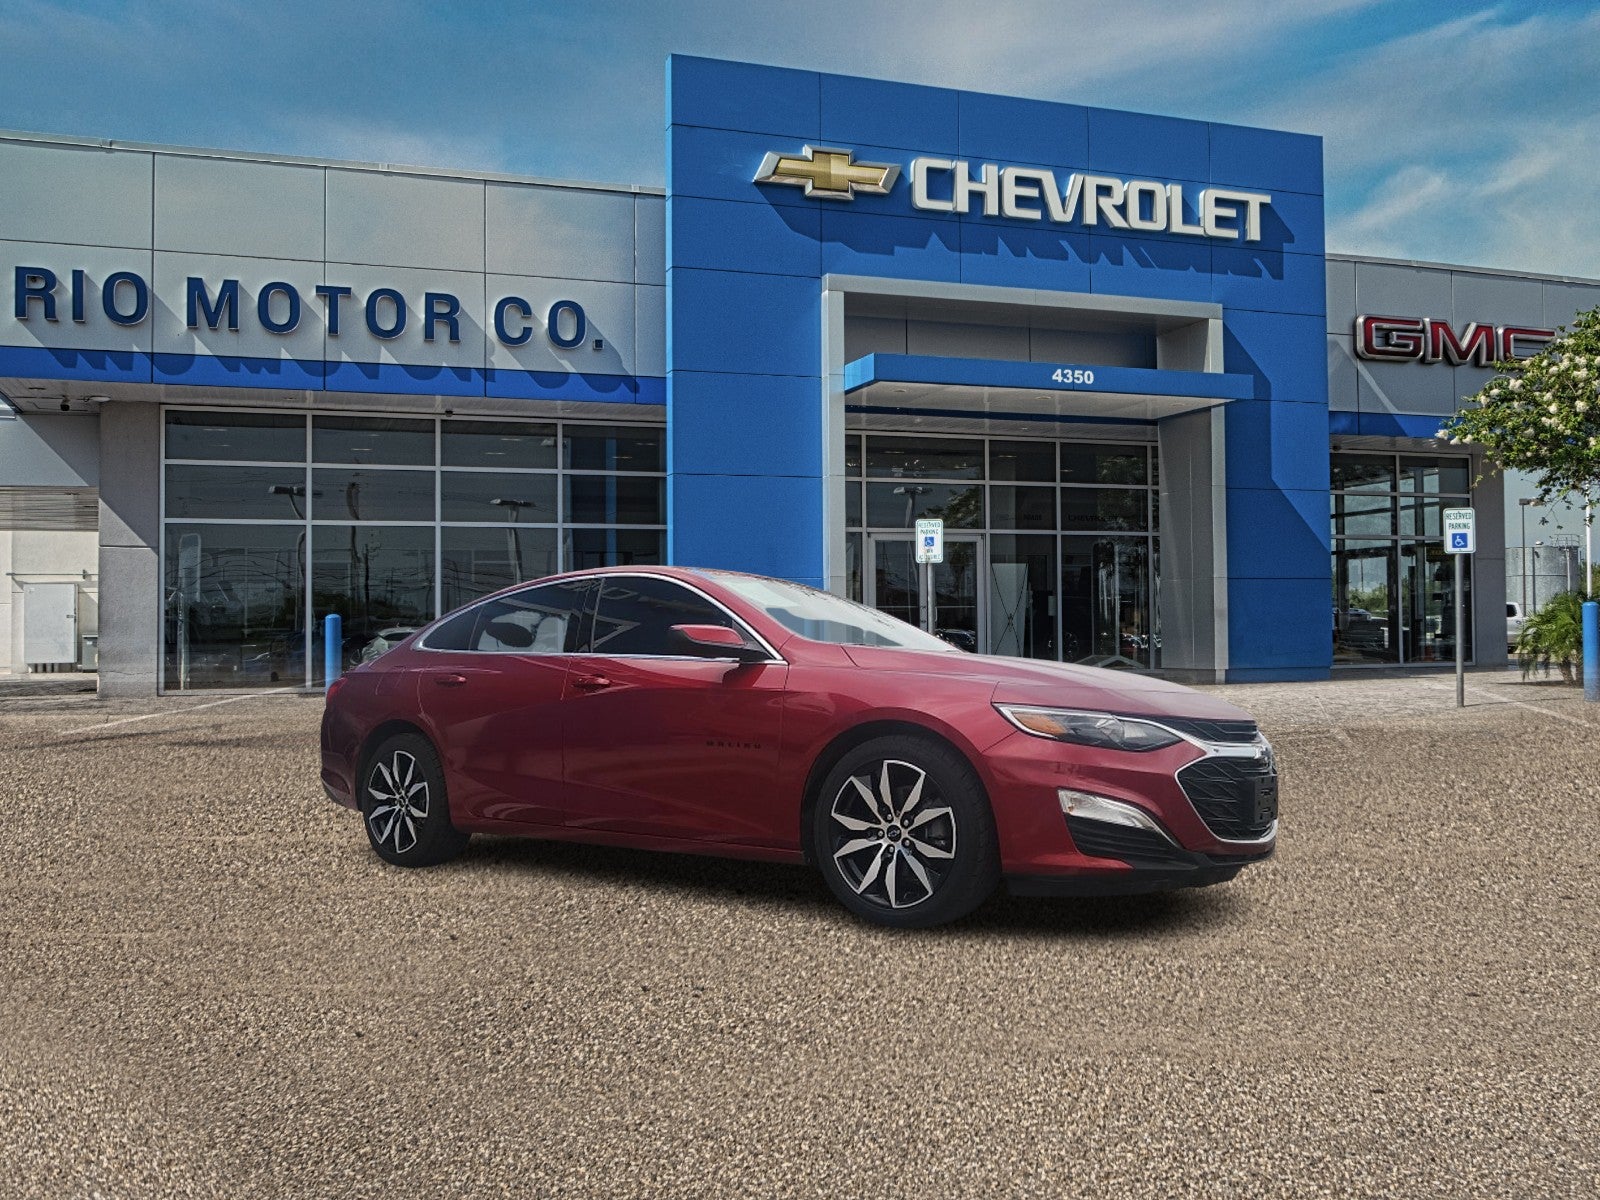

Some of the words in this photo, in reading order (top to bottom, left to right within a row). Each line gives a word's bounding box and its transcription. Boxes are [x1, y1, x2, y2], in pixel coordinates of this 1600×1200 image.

[910, 156, 1272, 242] CHEVROLET
[14, 266, 150, 327] RIO
[186, 276, 461, 343] MOTOR
[493, 296, 604, 350] CO.
[1354, 314, 1557, 367] GMC
[1051, 368, 1095, 385] 4350
[1445, 512, 1472, 521] RESERVED
[1448, 522, 1471, 530] PARKING
